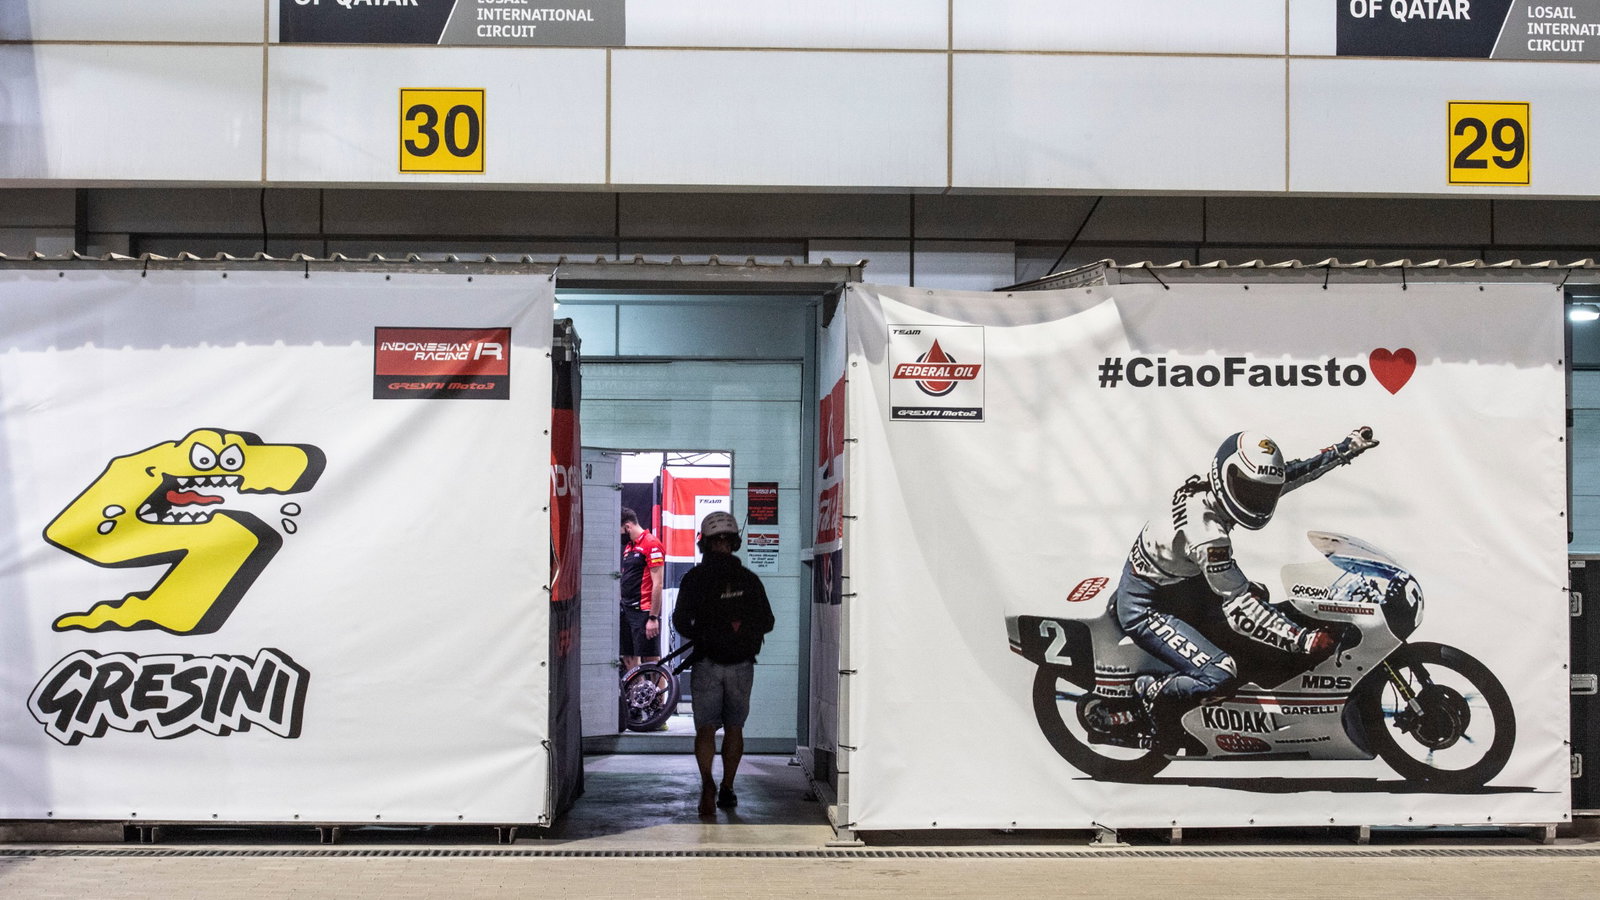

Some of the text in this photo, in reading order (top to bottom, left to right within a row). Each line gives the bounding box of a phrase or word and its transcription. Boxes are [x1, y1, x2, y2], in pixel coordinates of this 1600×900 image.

[476, 8, 595, 22] INTERNATIONAL
[1350, 0, 1471, 23] OF QATAR
[1527, 6, 1576, 20] LOSAIL
[476, 25, 537, 38] CIRCUIT
[1527, 39, 1585, 52] CIRCUIT
[404, 104, 480, 158] 30
[1453, 117, 1525, 169] 29
[380, 342, 472, 351] INDONESIAN
[414, 352, 470, 361] RACING
[898, 365, 974, 377] FEDERAL OIL
[1098, 356, 1367, 388] #CiaoFausto
[388, 382, 445, 390] GRESINI
[1257, 465, 1283, 478] MDS
[1039, 619, 1073, 666] 2
[1301, 674, 1352, 689] MDS
[27, 648, 310, 745] GRESINI
[1281, 705, 1338, 715] GARELLI
[1201, 707, 1271, 733] KODAK
